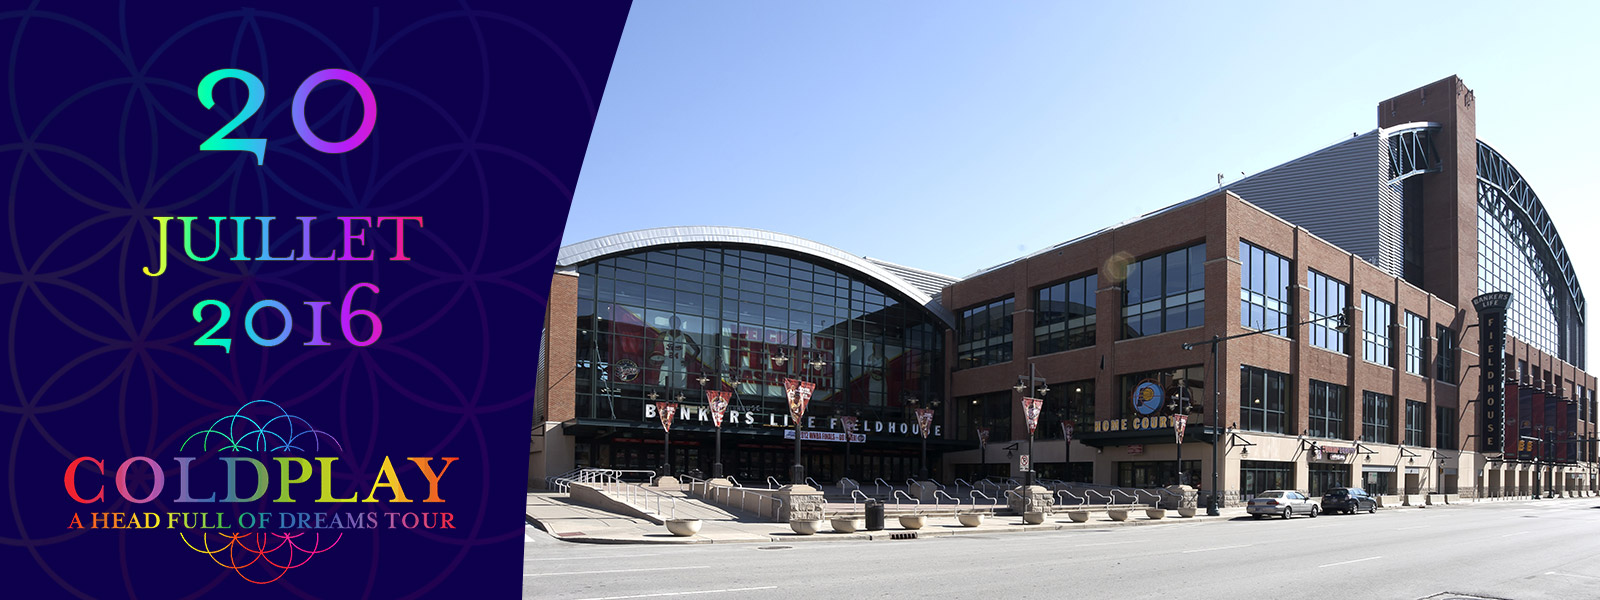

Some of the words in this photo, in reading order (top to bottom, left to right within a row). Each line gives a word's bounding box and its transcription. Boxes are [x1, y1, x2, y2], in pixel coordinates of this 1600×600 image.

[1473, 292, 1509, 305] BANKERS
[1482, 299, 1499, 308] LIFE
[1487, 317, 1495, 446] FIELDHOUSE
[645, 403, 754, 425] BNKRS
[769, 413, 816, 429] LIE
[830, 416, 941, 436] FELDHOUE
[1094, 418, 1128, 433] HOME
